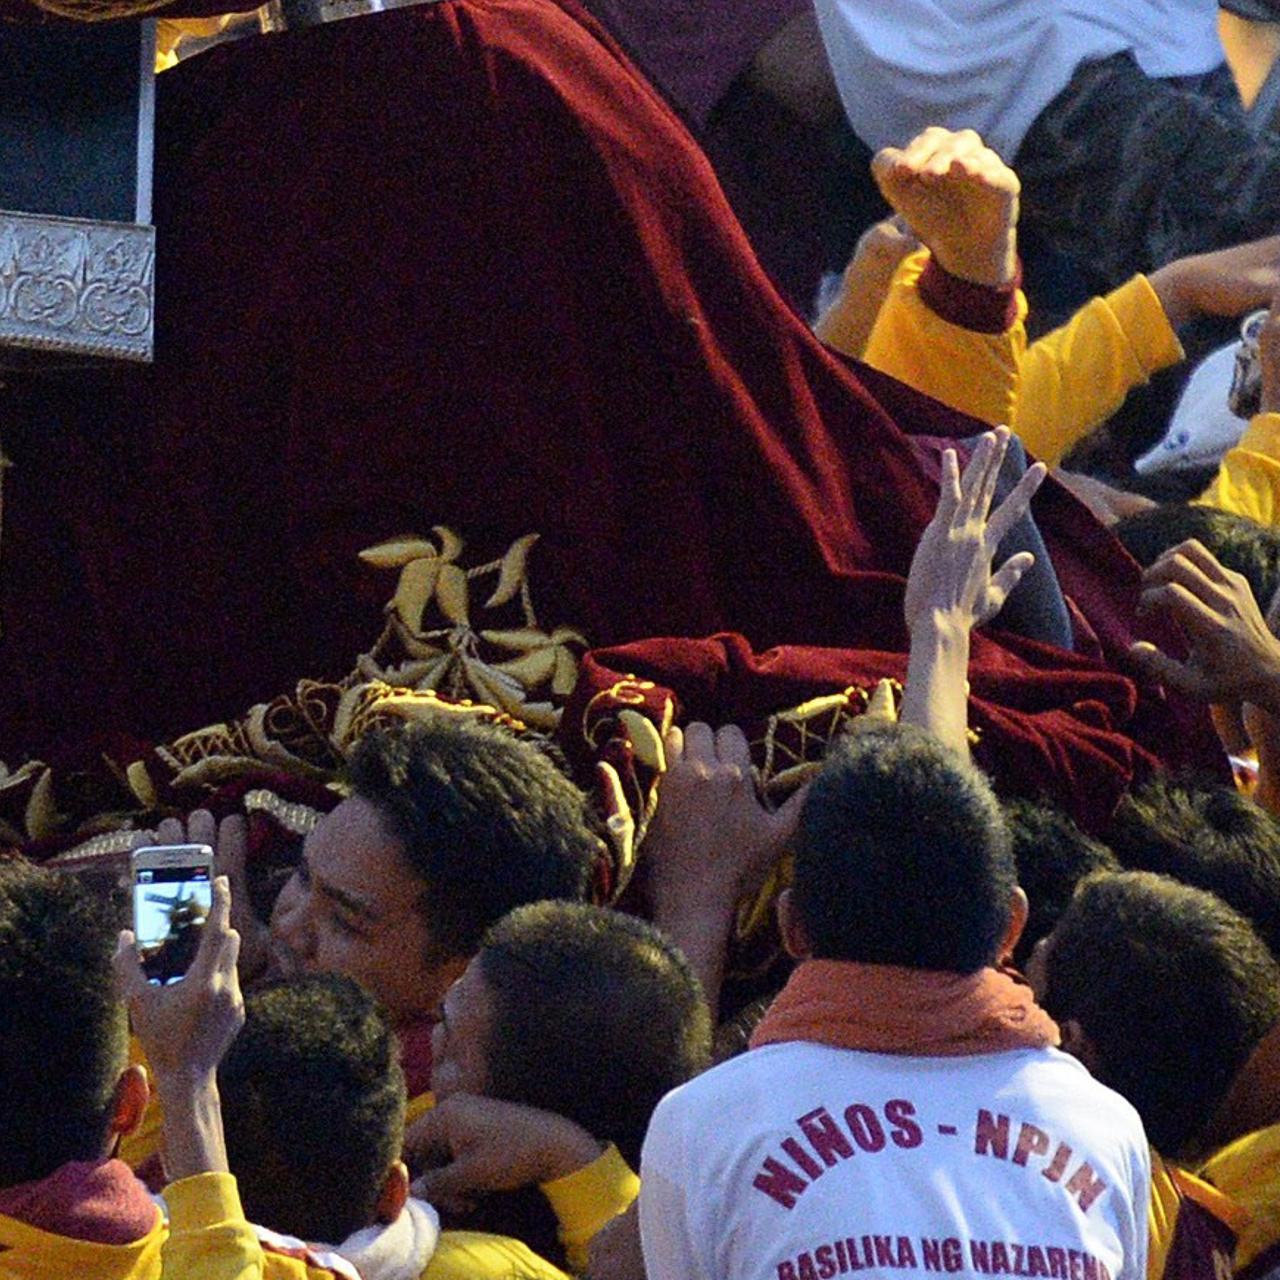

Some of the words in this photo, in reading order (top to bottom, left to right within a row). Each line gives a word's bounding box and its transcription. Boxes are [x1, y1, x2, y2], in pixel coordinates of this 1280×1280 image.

[753, 1098, 923, 1210] NIÑOS
[975, 1108, 1107, 1212] NPIN
[922, 1237, 964, 1273] NG
